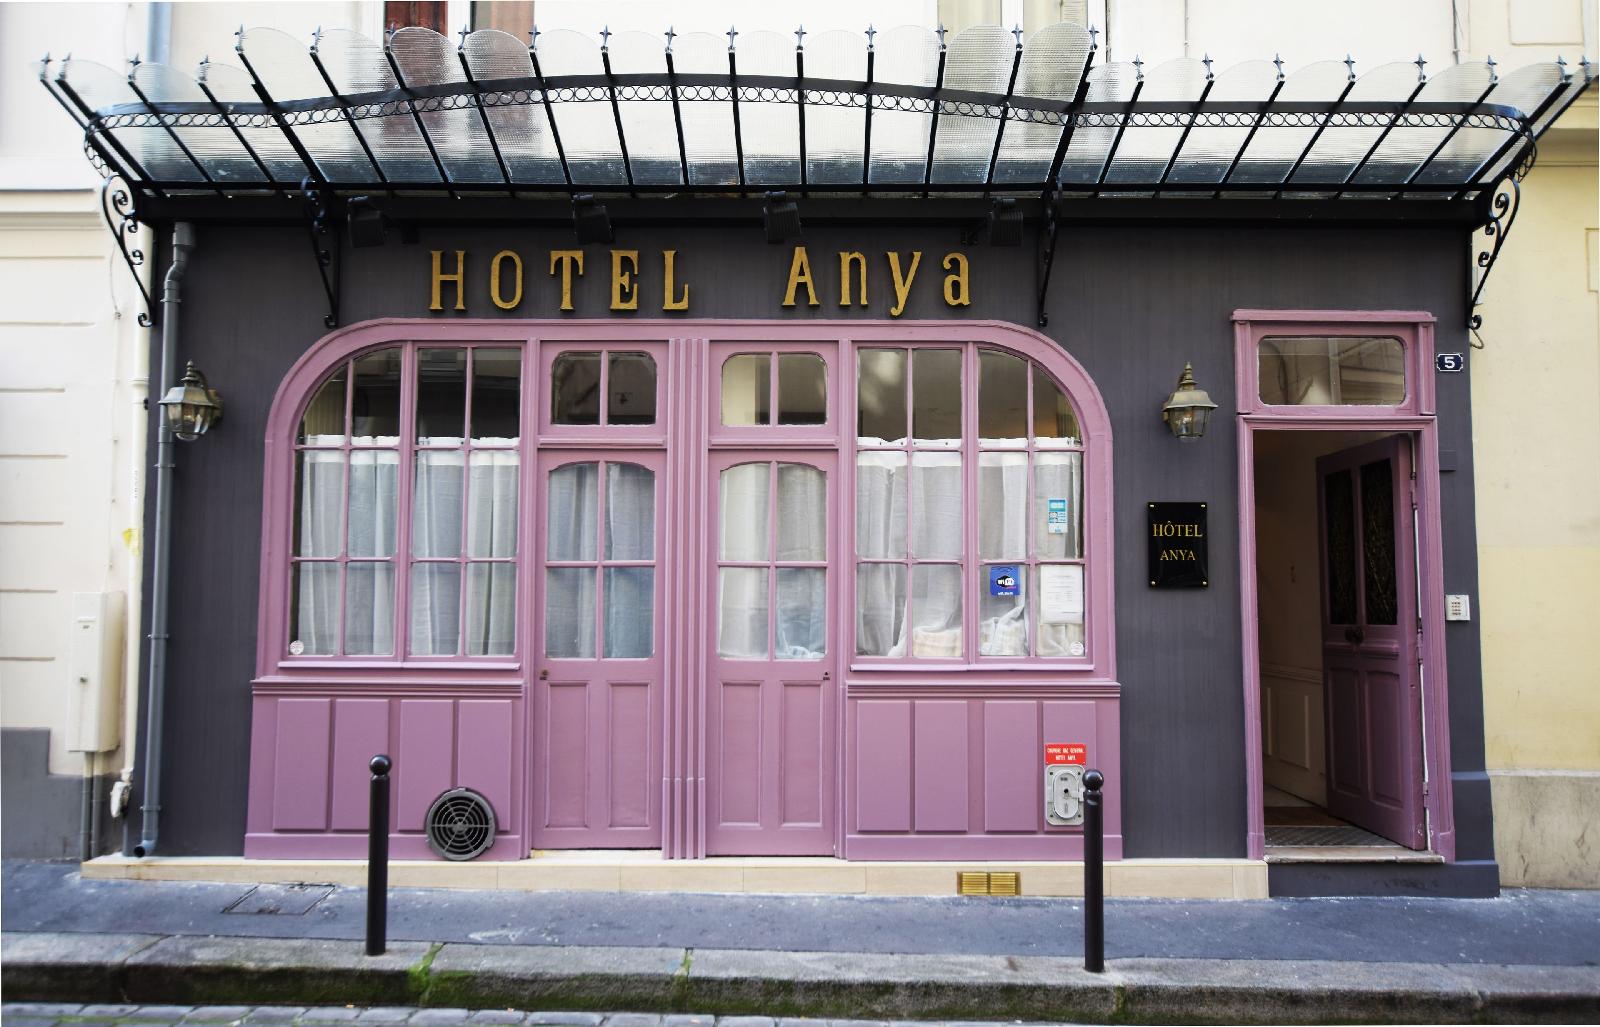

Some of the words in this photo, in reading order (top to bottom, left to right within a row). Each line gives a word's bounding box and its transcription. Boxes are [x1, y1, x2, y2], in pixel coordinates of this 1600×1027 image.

[429, 249, 690, 311] HOTEL
[781, 246, 971, 318] Anya
[1444, 356, 1456, 369] 5
[1152, 520, 1203, 537] HÔTEL
[1159, 549, 1196, 561] ANYA
